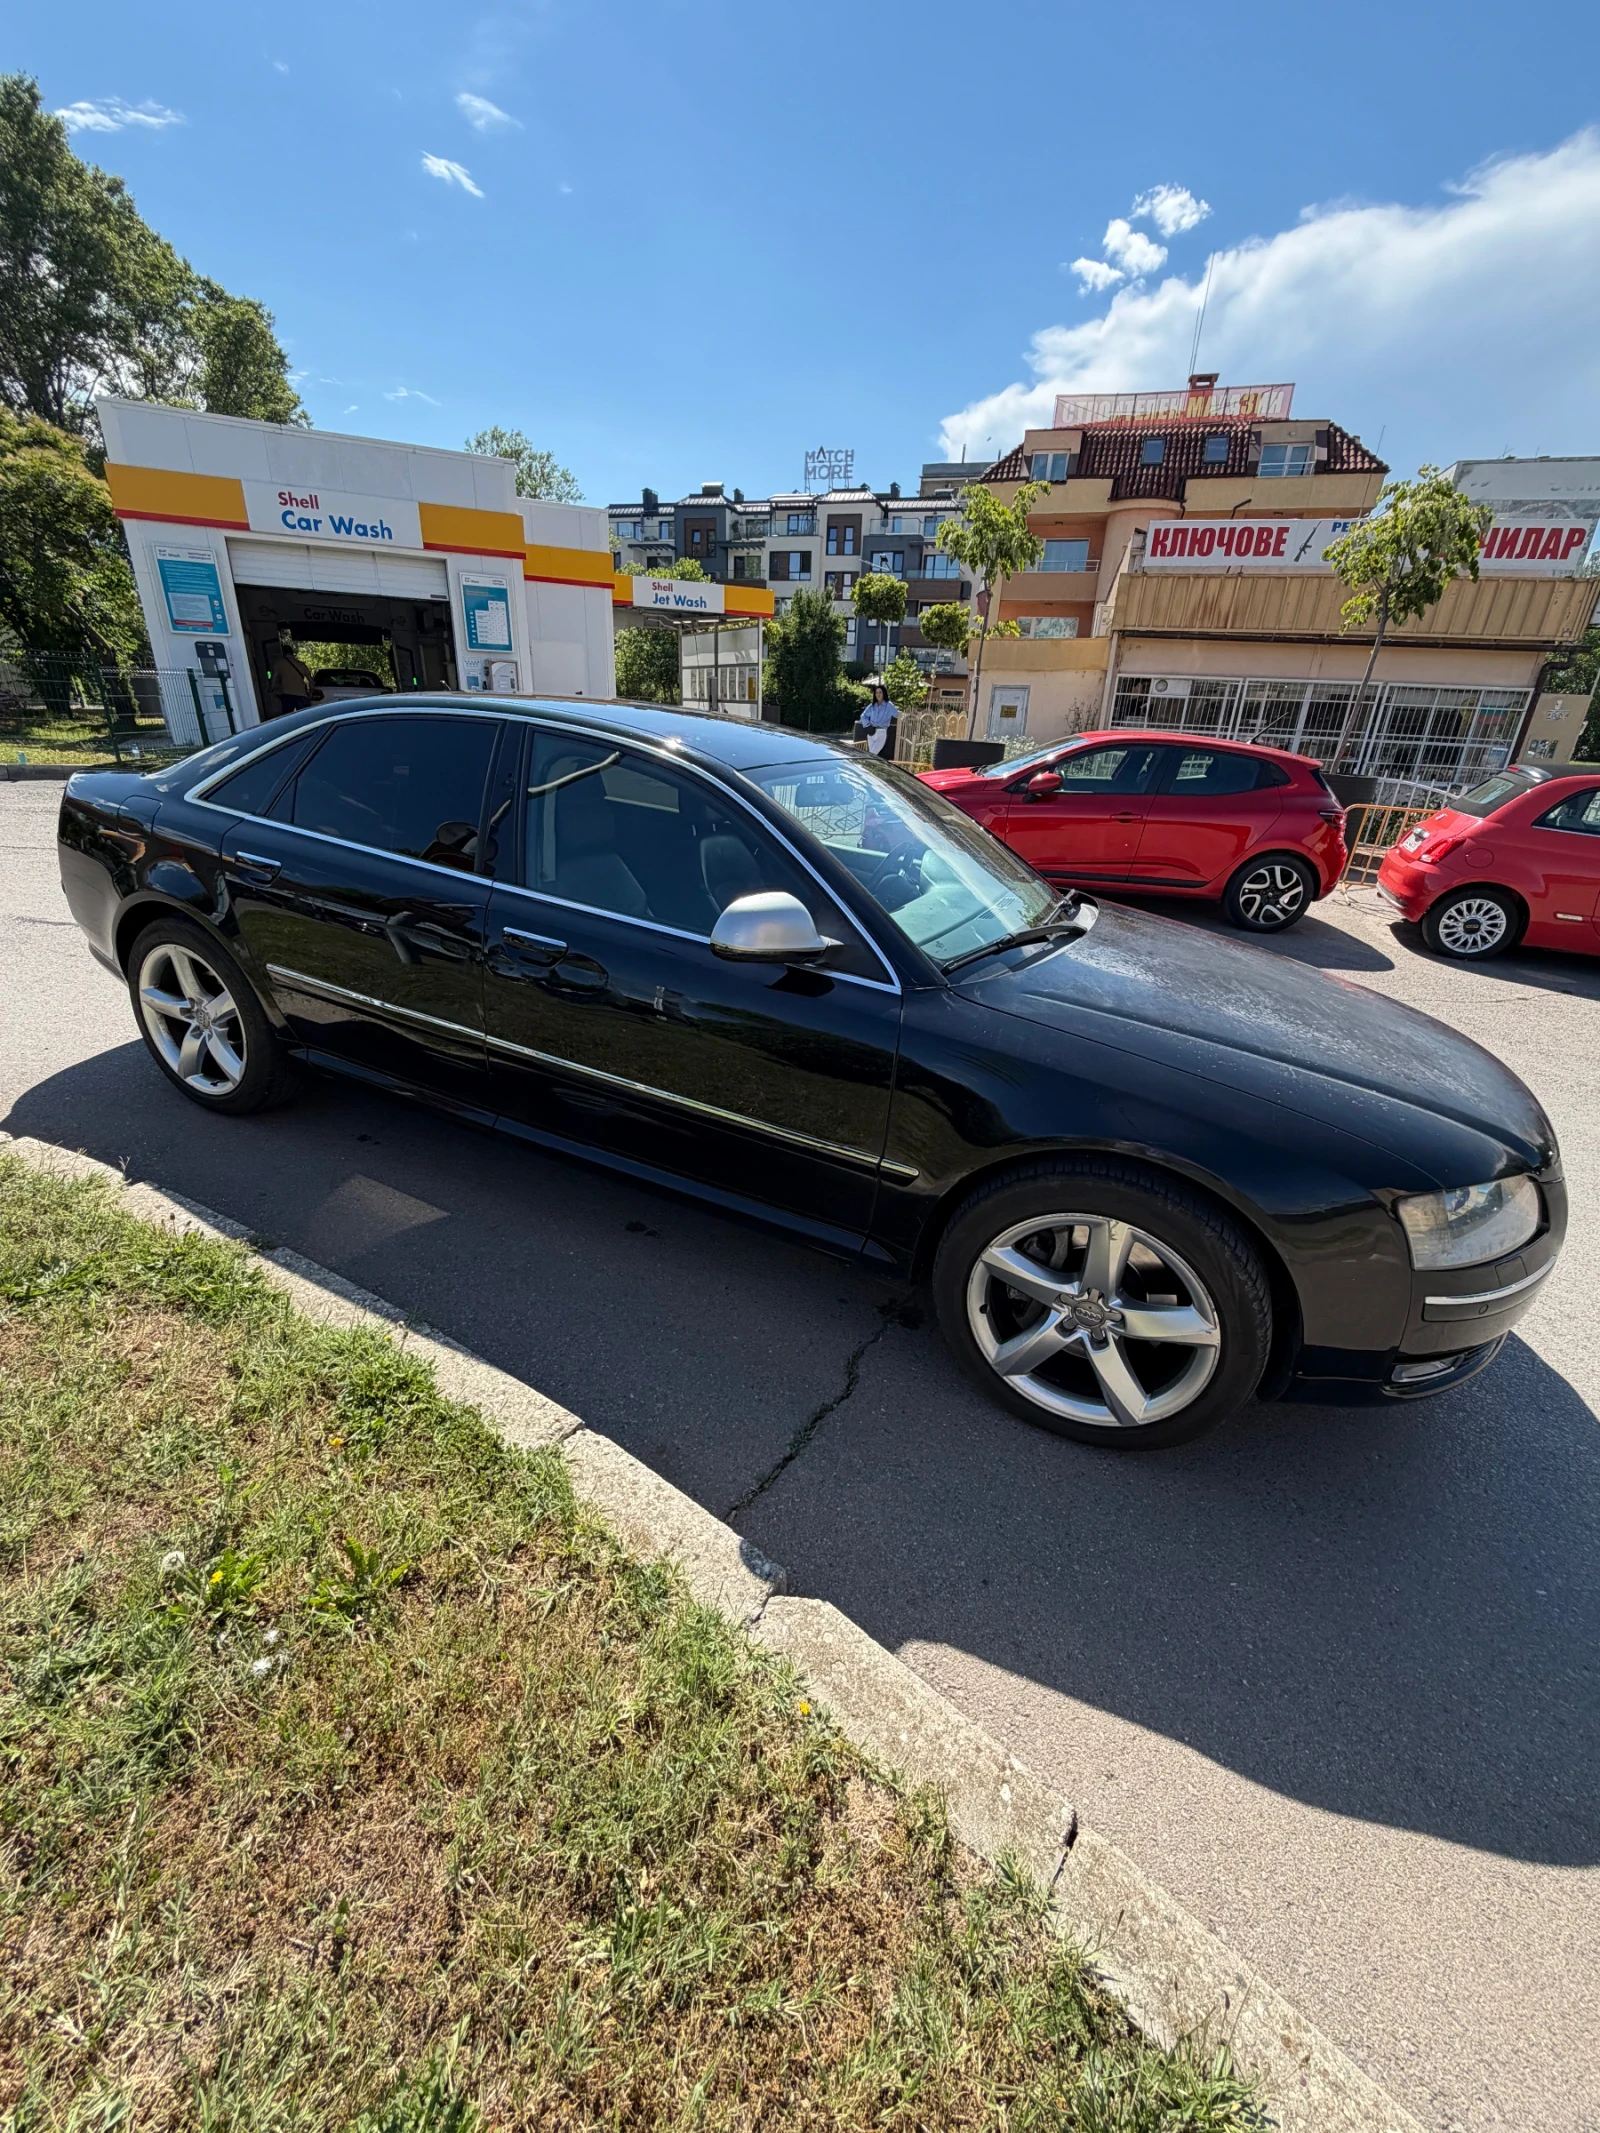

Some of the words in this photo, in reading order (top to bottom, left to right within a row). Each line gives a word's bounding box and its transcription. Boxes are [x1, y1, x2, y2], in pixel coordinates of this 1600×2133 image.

[805, 445, 854, 463] MATCH
[804, 464, 854, 480] MORE
[278, 491, 319, 510] Shell
[281, 510, 322, 532] Car
[328, 515, 393, 540] Wash
[1150, 526, 1290, 557] КЛЮЧОВЕ
[1476, 527, 1587, 560] ЧИЛАР
[652, 581, 673, 592] Shell
[652, 593, 670, 605] Jet
[673, 594, 707, 609] Wash
[303, 607, 326, 621] Car
[328, 609, 365, 624] Wash
